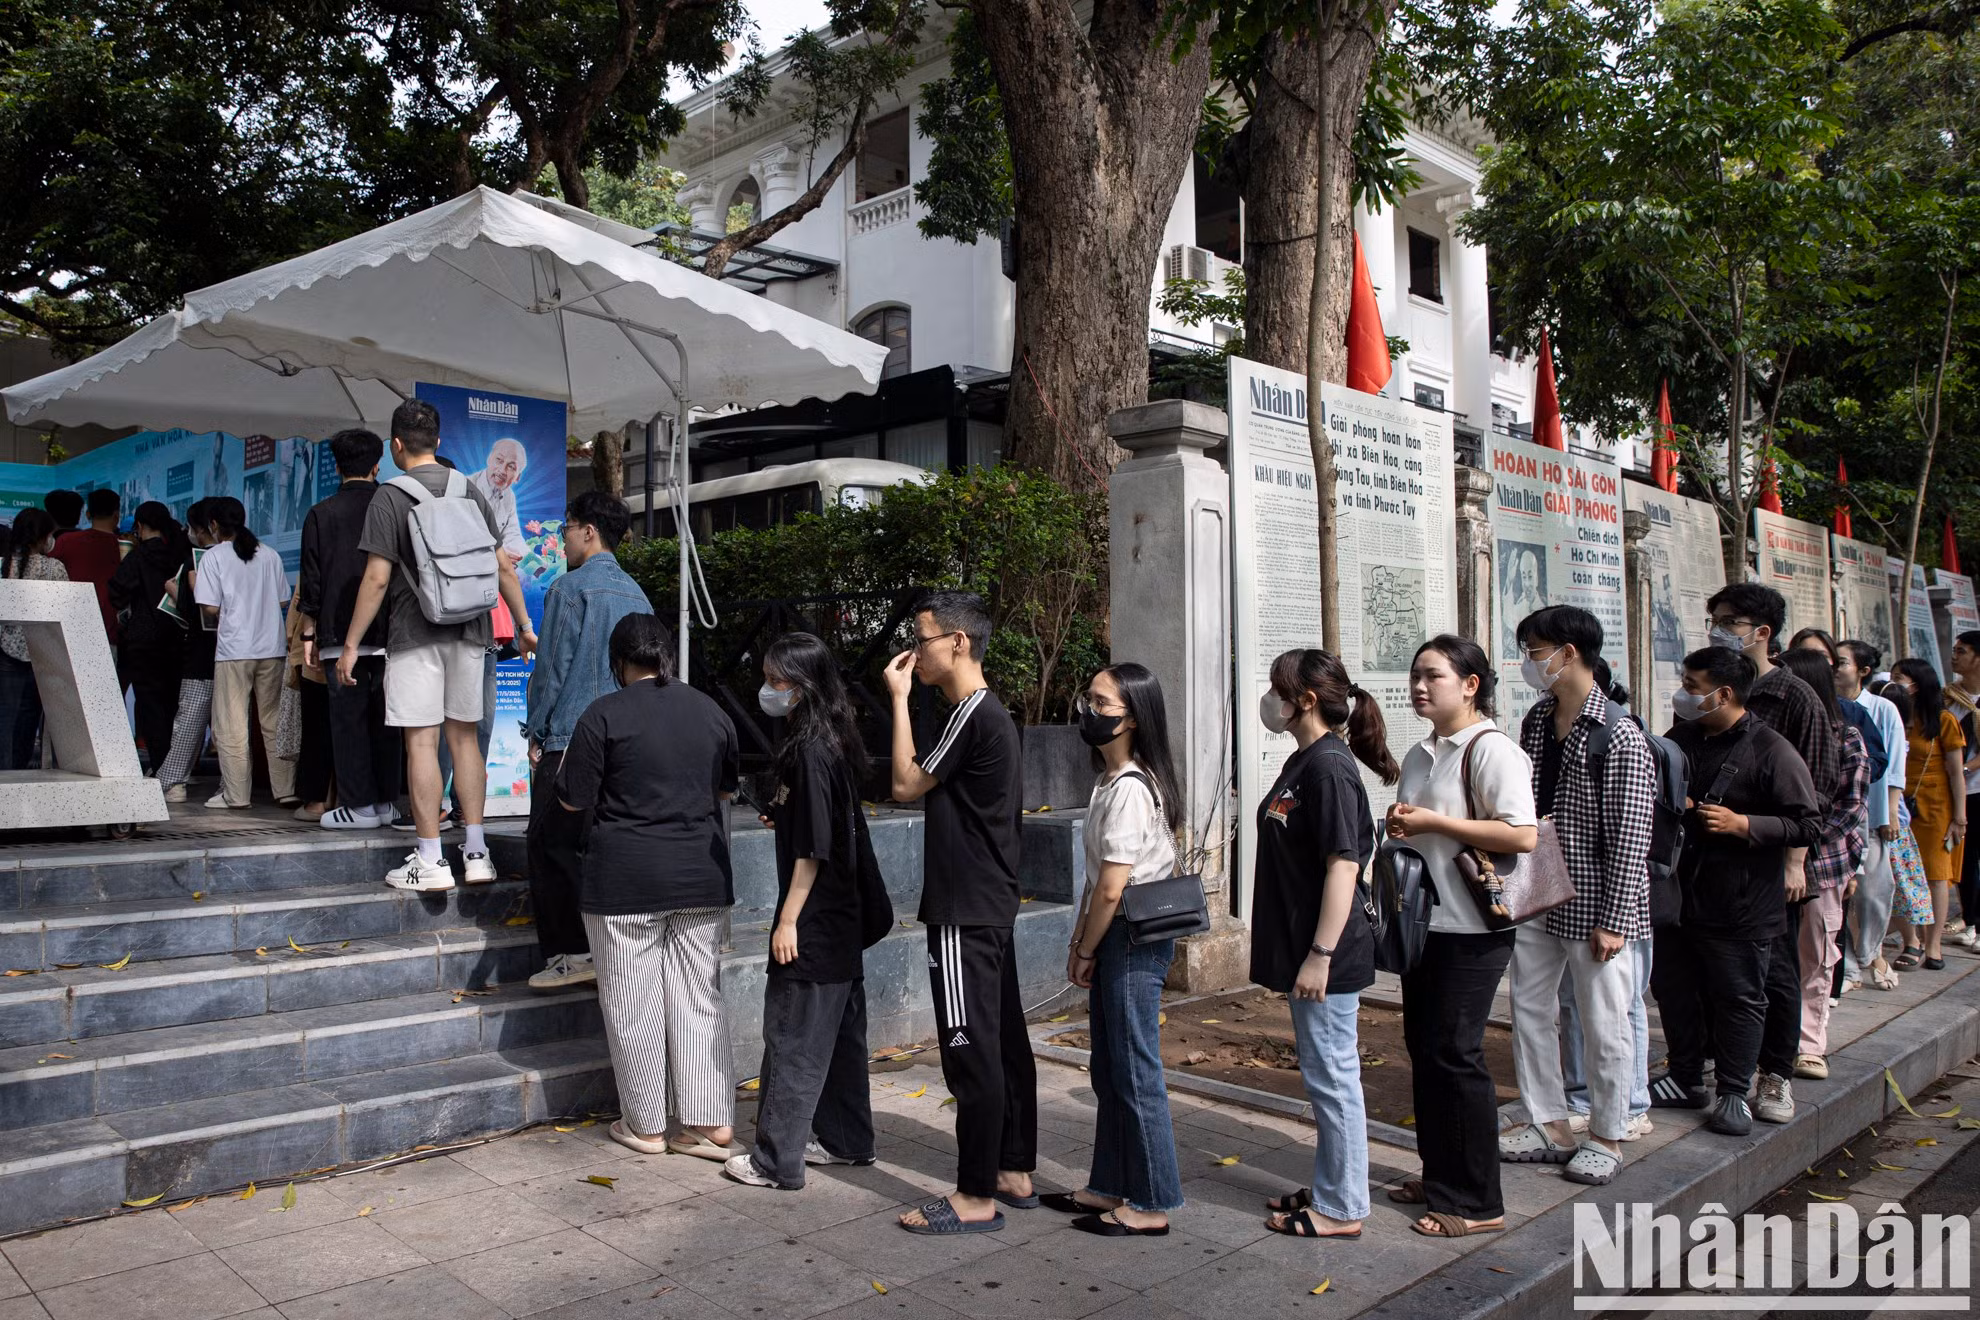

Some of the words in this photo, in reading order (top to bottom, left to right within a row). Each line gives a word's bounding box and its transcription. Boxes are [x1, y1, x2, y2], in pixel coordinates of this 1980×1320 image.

[468, 396, 497, 413] Nhân
[497, 400, 519, 416] Dân
[1250, 376, 1293, 417] Nhân
[1331, 413, 1347, 433] Giải
[1353, 420, 1377, 442] phóng
[1382, 426, 1401, 446] hoàn
[1405, 433, 1421, 451] toàn
[1347, 444, 1358, 459] xã
[1362, 444, 1379, 464] Biên
[1383, 449, 1400, 471] Hòa,
[1405, 456, 1422, 475] cảng
[1493, 449, 1537, 479] HOAN
[1542, 461, 1562, 485] HÔ
[1567, 465, 1587, 490] SÀI
[1592, 472, 1616, 496] GÒN
[1277, 469, 1293, 488] HIỆU
[1296, 472, 1312, 490] NGÀY
[1390, 475, 1407, 493] Biên
[1408, 479, 1423, 496] Hòa
[1342, 493, 1352, 507] và
[1374, 495, 1400, 515] Phước
[1403, 500, 1416, 520] Tuy
[1496, 483, 1523, 511] Nhân
[1523, 488, 1542, 514] Dân
[1543, 489, 1571, 515] GIẢI
[1575, 497, 1617, 524] PHÓNG
[1577, 527, 1600, 543] Chiến
[1603, 531, 1619, 546] dịch
[1571, 547, 1583, 562] Hồ
[1586, 549, 1599, 564] Chí
[1601, 551, 1620, 567] Minh
[1572, 570, 1593, 585] toàn
[1598, 571, 1621, 592] thắng
